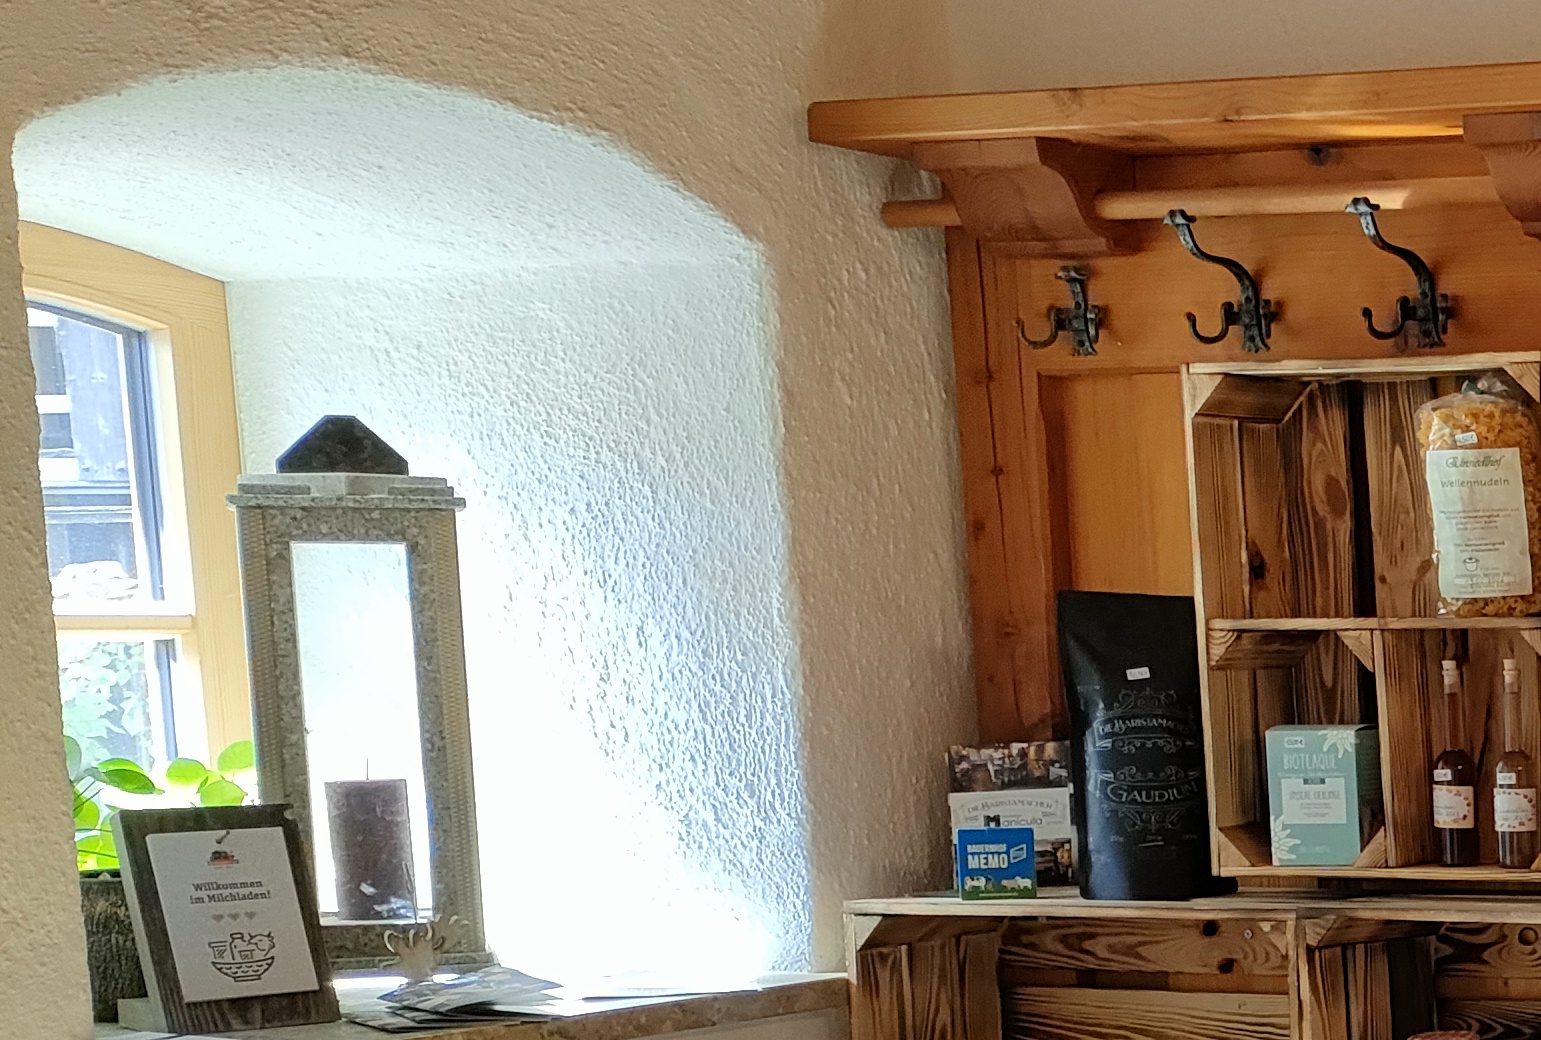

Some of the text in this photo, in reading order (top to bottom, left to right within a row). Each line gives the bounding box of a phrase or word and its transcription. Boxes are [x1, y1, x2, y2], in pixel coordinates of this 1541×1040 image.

[1440, 477, 1510, 489] Wellennudeln
[1283, 753, 1338, 771] BIOTEAQUE
[1106, 780, 1198, 802] GAUDIUM
[967, 853, 1009, 869] MEMO
[192, 880, 264, 892] Willkommen
[190, 889, 272, 905] im Milchladen!
